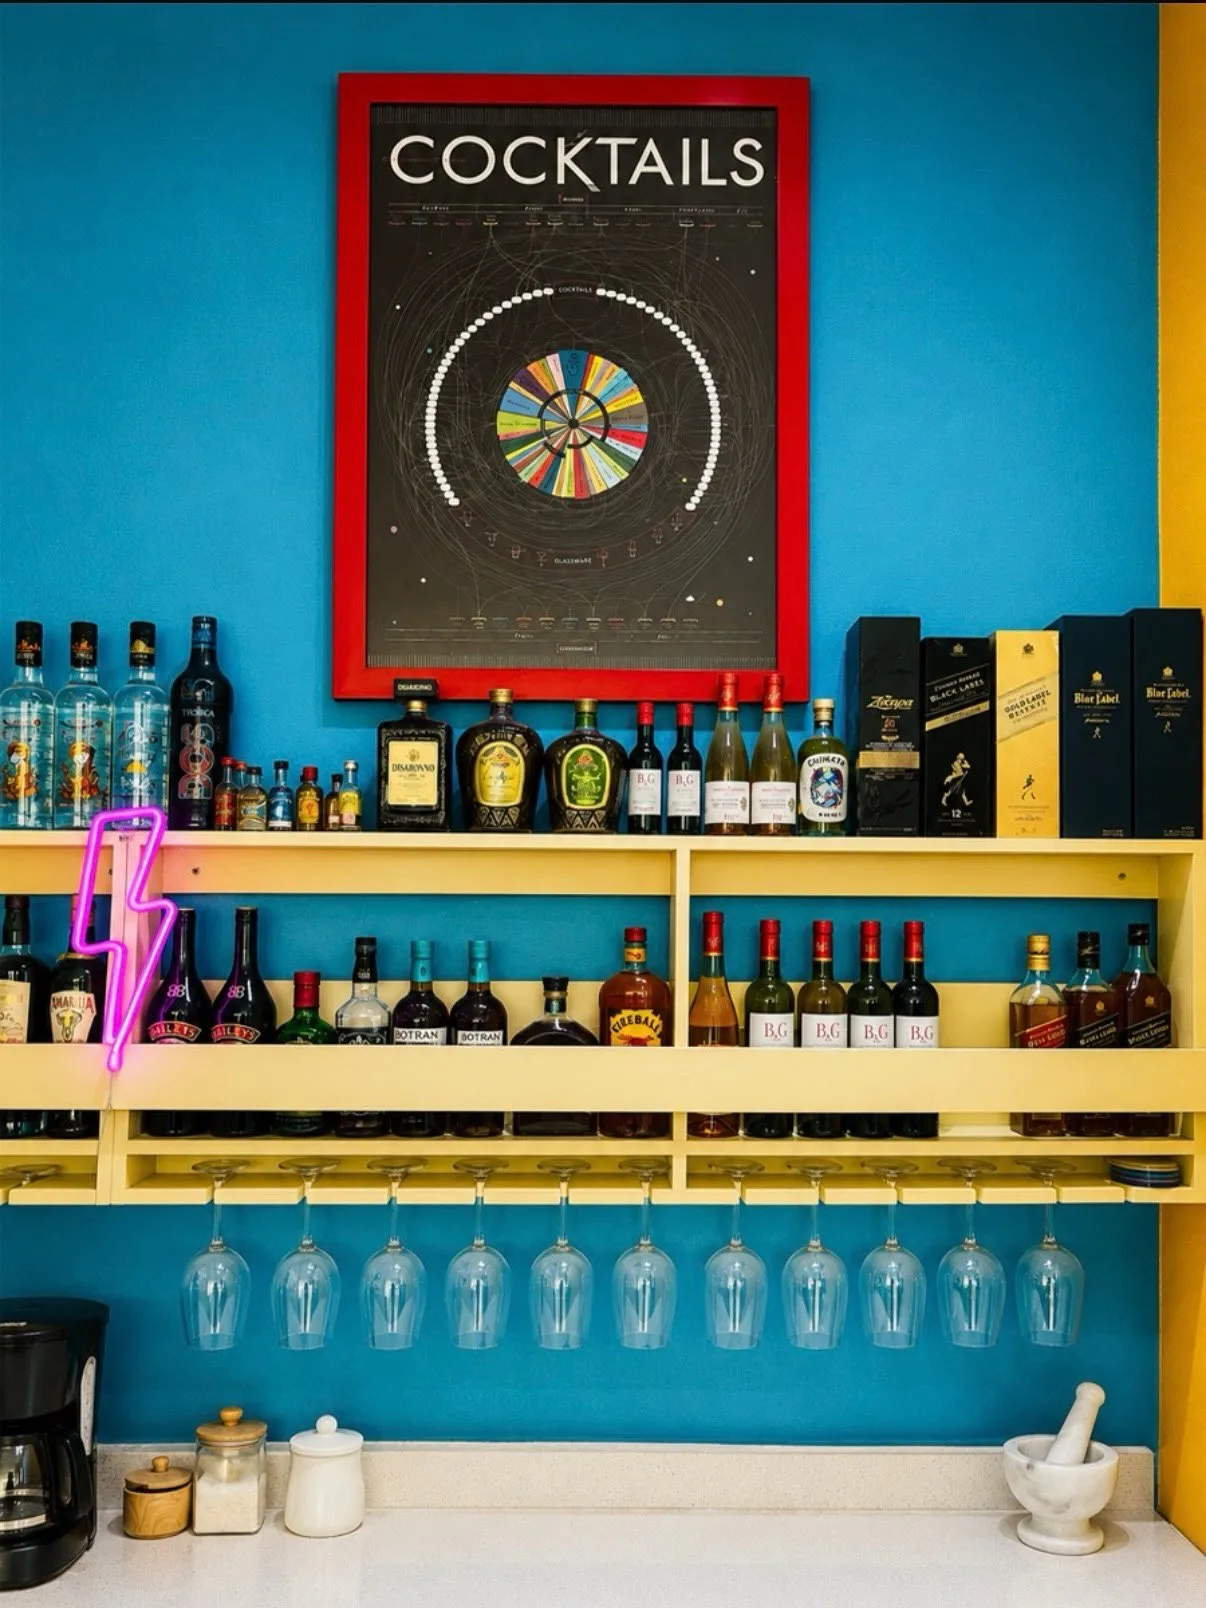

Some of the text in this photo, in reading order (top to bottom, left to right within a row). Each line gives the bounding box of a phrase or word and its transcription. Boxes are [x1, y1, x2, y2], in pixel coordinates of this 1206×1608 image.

[390, 134, 765, 192] COCKTAILS
[392, 763, 435, 772] DISARONNO
[637, 773, 655, 786] B&G
[675, 774, 694, 787] B&G
[951, 809, 962, 818] 12
[611, 1014, 660, 1034] FIREBALL
[764, 1022, 788, 1038] B&G
[816, 1022, 840, 1038] B&G
[864, 1023, 888, 1039] B&G
[395, 1030, 439, 1040] BOTRAN
[461, 1033, 500, 1042] BOTRAN
[911, 1024, 934, 1040] B&G
